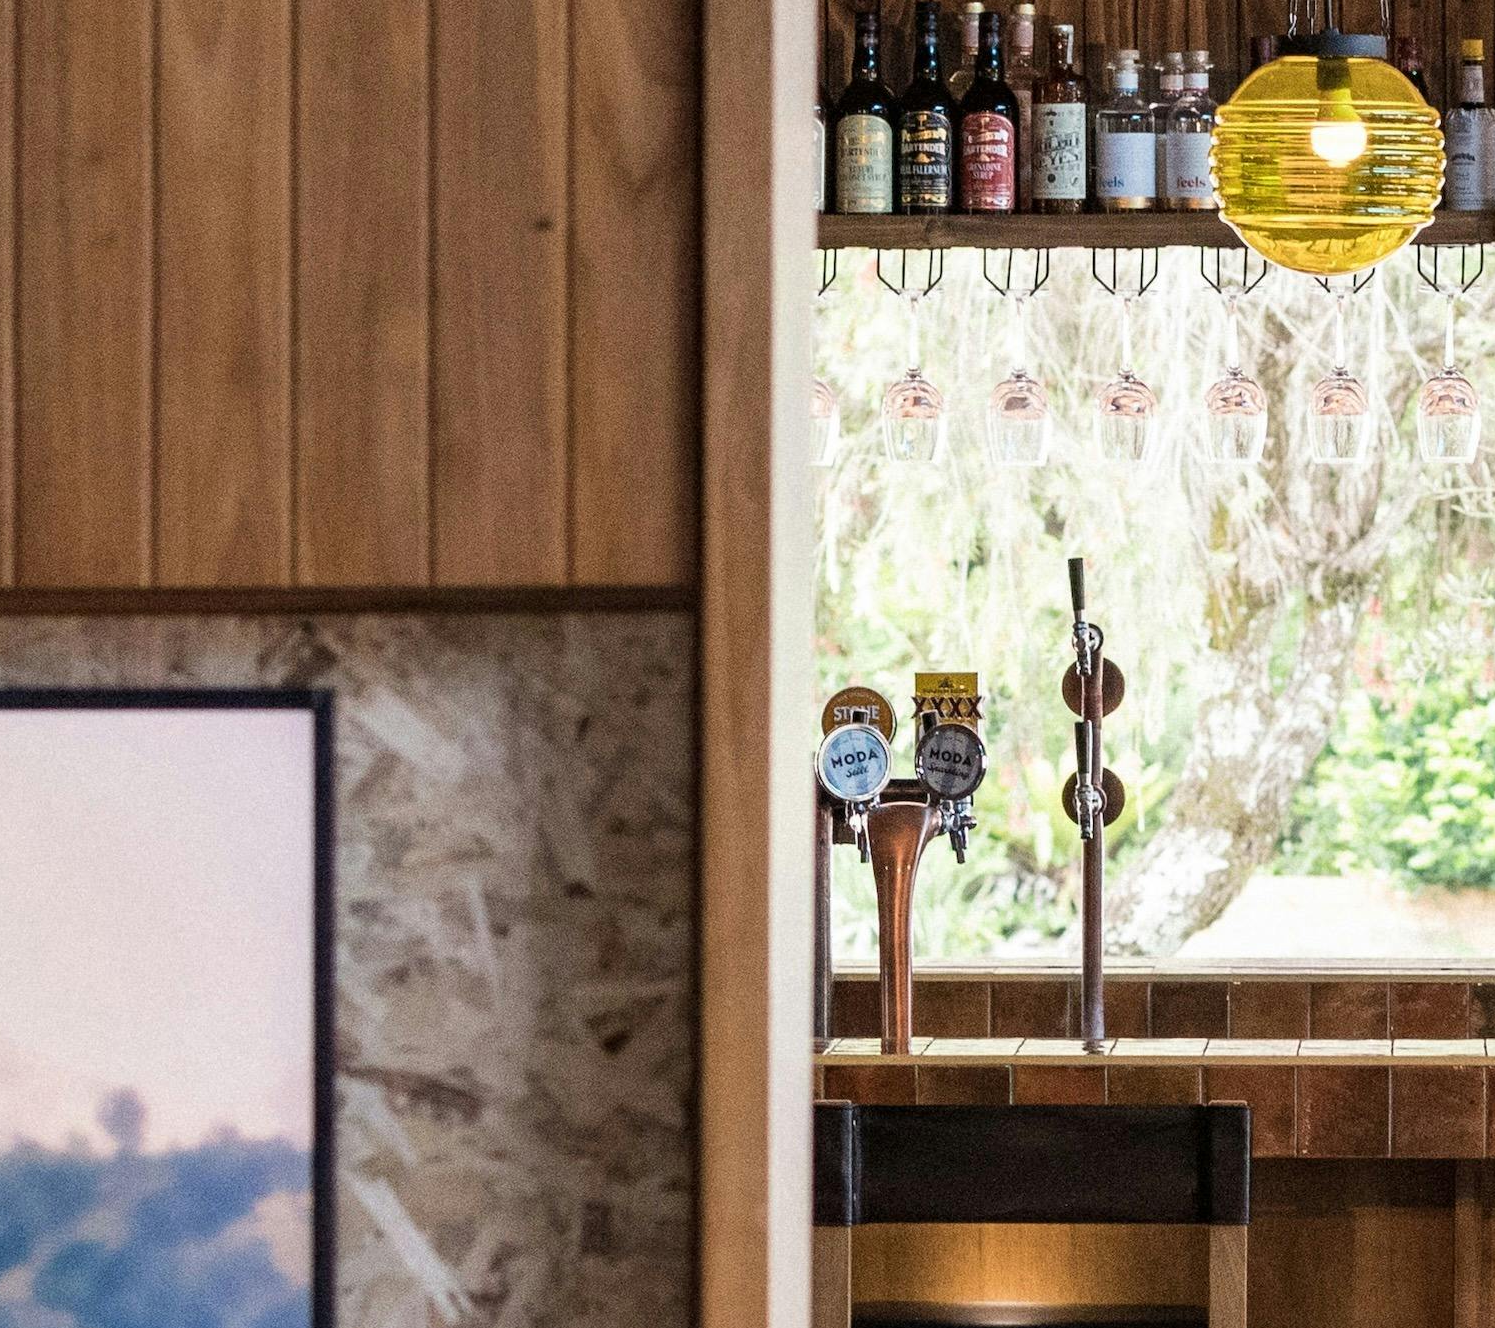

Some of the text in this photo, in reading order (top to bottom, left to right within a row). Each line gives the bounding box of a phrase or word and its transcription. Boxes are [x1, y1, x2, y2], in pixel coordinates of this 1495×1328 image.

[1176, 176, 1207, 189] feels
[911, 696, 983, 719] XXXX
[831, 748, 880, 769] MODA
[928, 747, 972, 768] MODA
